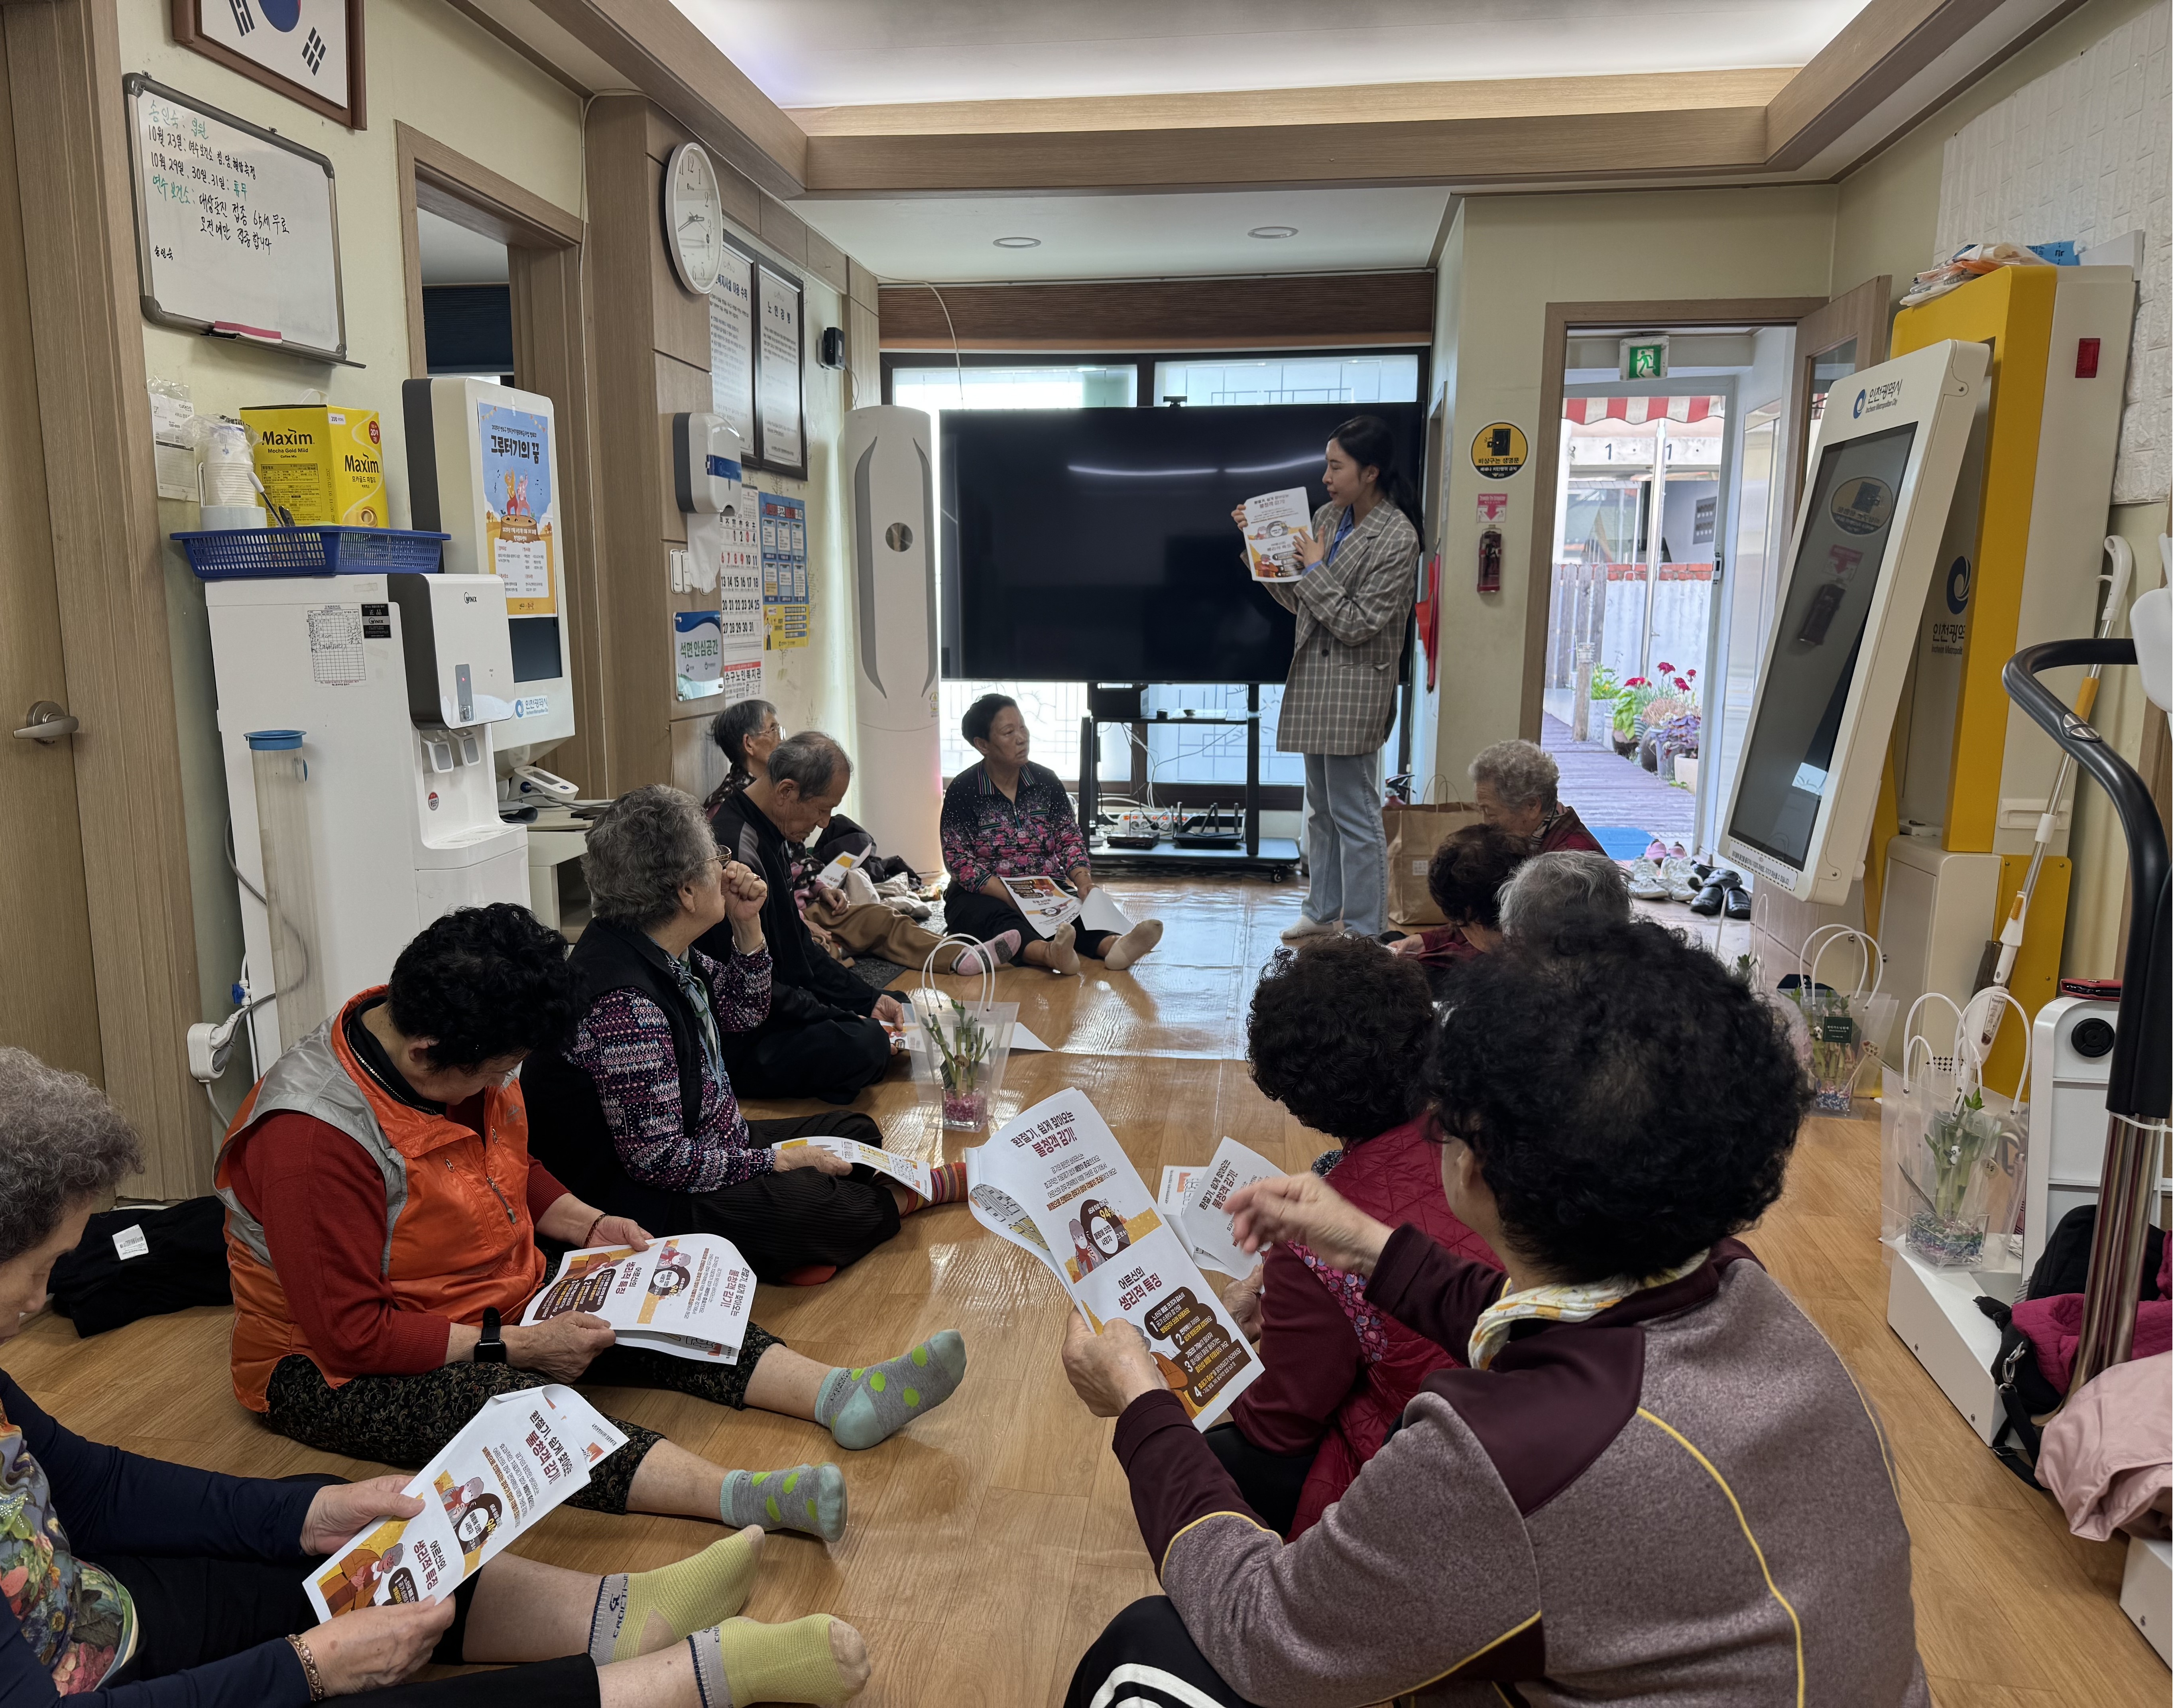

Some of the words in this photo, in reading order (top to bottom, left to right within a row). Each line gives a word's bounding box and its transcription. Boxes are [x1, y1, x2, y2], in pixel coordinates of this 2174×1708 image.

[149, 125, 164, 147] 10월
[151, 152, 166, 171] 10월
[688, 155, 694, 173] 12
[698, 169, 701, 184] 1
[705, 191, 708, 207] 2
[708, 219, 712, 235] 3
[1868, 379, 1902, 404] 인천광역시
[262, 427, 314, 445] Maxim
[491, 435, 529, 459] 그루터기의
[532, 443, 539, 464] 꿈
[344, 453, 380, 473] Maxim
[740, 531, 743, 542] 2
[746, 555, 751, 565] 10
[753, 555, 757, 566] 11
[721, 577, 726, 587] 13
[728, 577, 732, 587] 14
[734, 577, 739, 587] 15
[741, 577, 745, 587] 16
[747, 577, 751, 588] 17
[754, 578, 758, 588] 18
[722, 600, 727, 610] 20
[729, 600, 734, 610] 21
[735, 600, 740, 610] 22
[742, 600, 747, 610] 23
[748, 599, 753, 610] 24
[755, 599, 759, 610] 25
[723, 623, 728, 634] 27
[730, 623, 735, 633] 28
[736, 622, 741, 633] 29
[742, 622, 748, 632] 30
[749, 622, 754, 632] 31
[681, 642, 693, 658] 석면
[694, 639, 718, 657] 안심공간
[525, 699, 548, 709] 인천광역시
[1010, 1128, 1041, 1148] 환절기,
[1037, 1120, 1054, 1135] 쉽게
[1050, 1111, 1075, 1129] 찾아오는
[1032, 1135, 1062, 1158] 불청객
[1057, 1127, 1077, 1146] 감기!
[1199, 1190, 1215, 1210] 환절기,
[1210, 1177, 1221, 1190] 쉽게
[1216, 1159, 1231, 1179] 찾아오는
[1212, 1185, 1231, 1210] 불청객
[1224, 1169, 1238, 1187] 감기!
[1099, 1206, 1116, 1221] 94%
[621, 1262, 636, 1279] 생리적
[629, 1267, 642, 1287] 어르신의
[725, 1269, 740, 1290] 불청객
[1118, 1266, 1145, 1289] 어르신의
[616, 1281, 628, 1294] 특징
[736, 1283, 746, 1294] 쉽게
[1118, 1284, 1147, 1311] 생리적
[1142, 1273, 1162, 1292] 특징
[720, 1291, 734, 1308] 감기!
[731, 1295, 743, 1316] 찾아오는
[1150, 1321, 1159, 1332] 1
[1175, 1333, 1185, 1346] 2
[1184, 1360, 1193, 1372] 3
[1194, 1386, 1202, 1397] 4
[529, 1410, 551, 1440] 환절기,
[548, 1437, 564, 1456] 쉽게
[558, 1452, 573, 1477] 찾아오는
[525, 1430, 552, 1466] 불청객
[543, 1460, 561, 1485] 감기!
[413, 1539, 433, 1572] 생리적
[426, 1568, 439, 1590] 특징
[430, 1540, 447, 1572] 어르신의
[395, 1574, 403, 1584] 1
